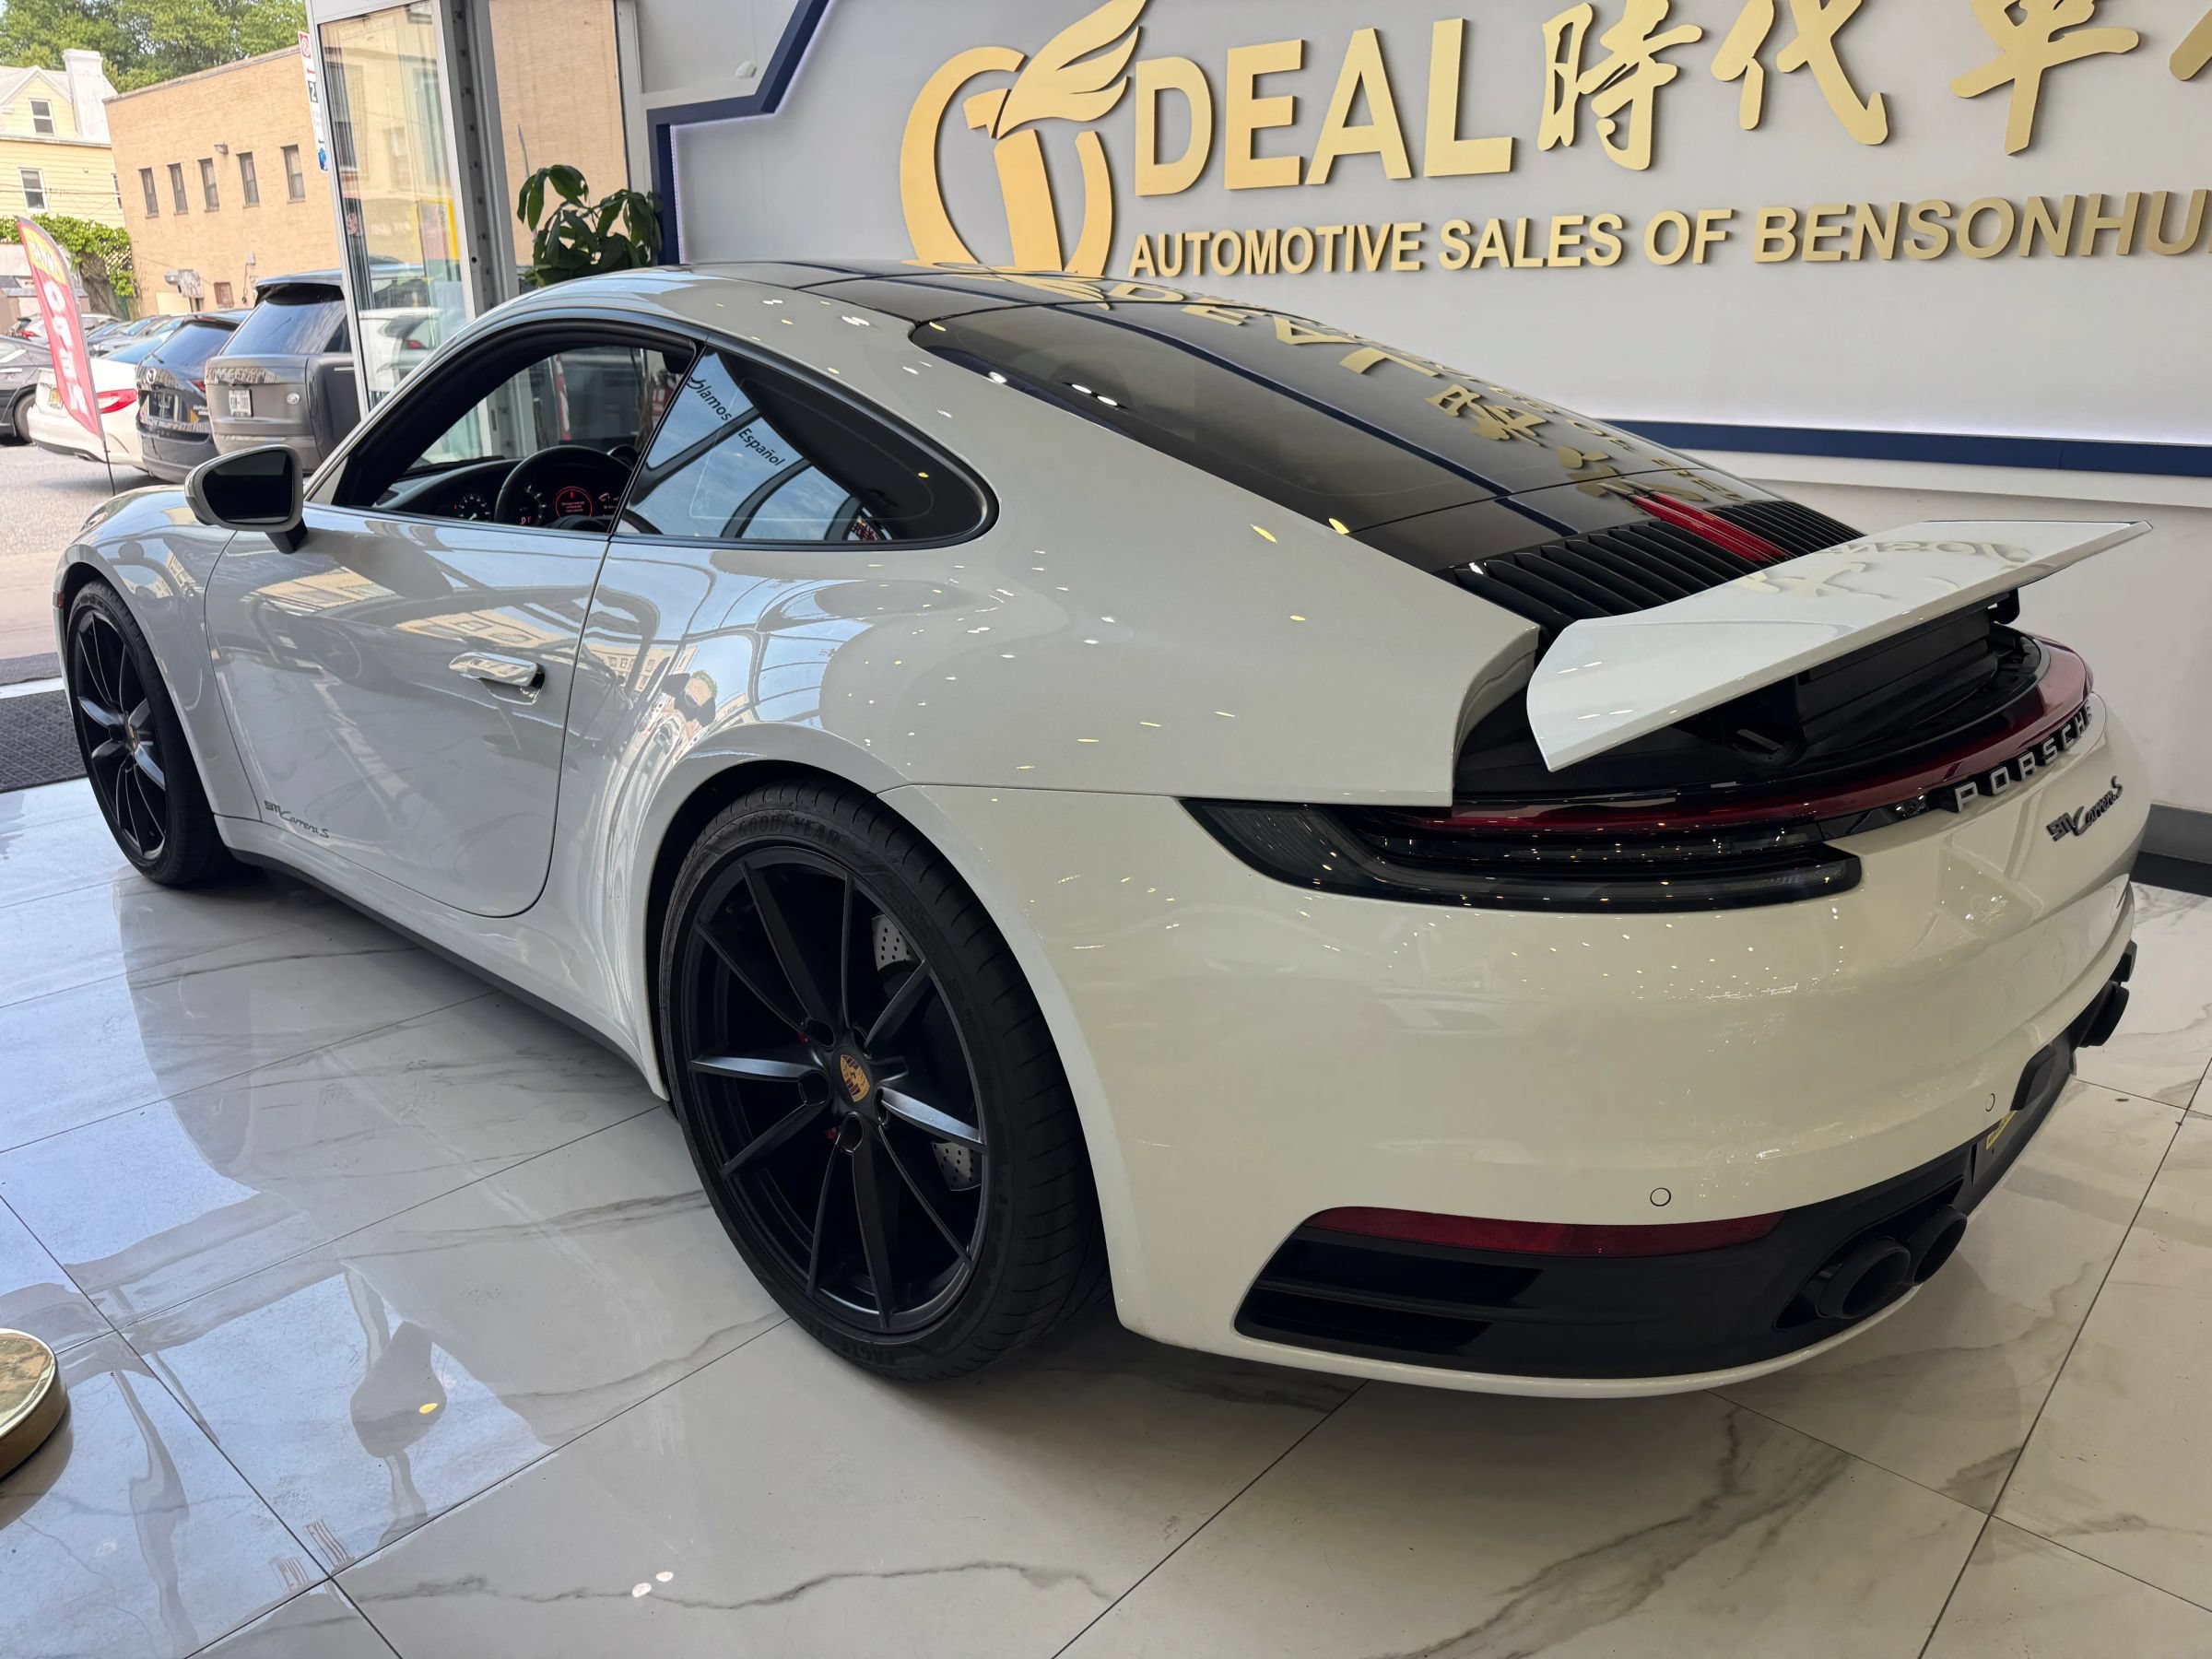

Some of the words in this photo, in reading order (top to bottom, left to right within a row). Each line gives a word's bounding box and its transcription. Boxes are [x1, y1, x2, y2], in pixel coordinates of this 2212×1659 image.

[1135, 18, 1514, 196] DEAL
[1127, 221, 1424, 277] AUTOMOTIVE
[1438, 213, 1624, 270] SALES
[1643, 209, 1734, 266] OF
[1754, 189, 2212, 265] BENSONHU
[737, 427, 786, 466] Español
[1953, 698, 2093, 813] PORSCHE
[2110, 775, 2123, 799] S
[279, 810, 319, 834] Carrera
[320, 828, 329, 838] S
